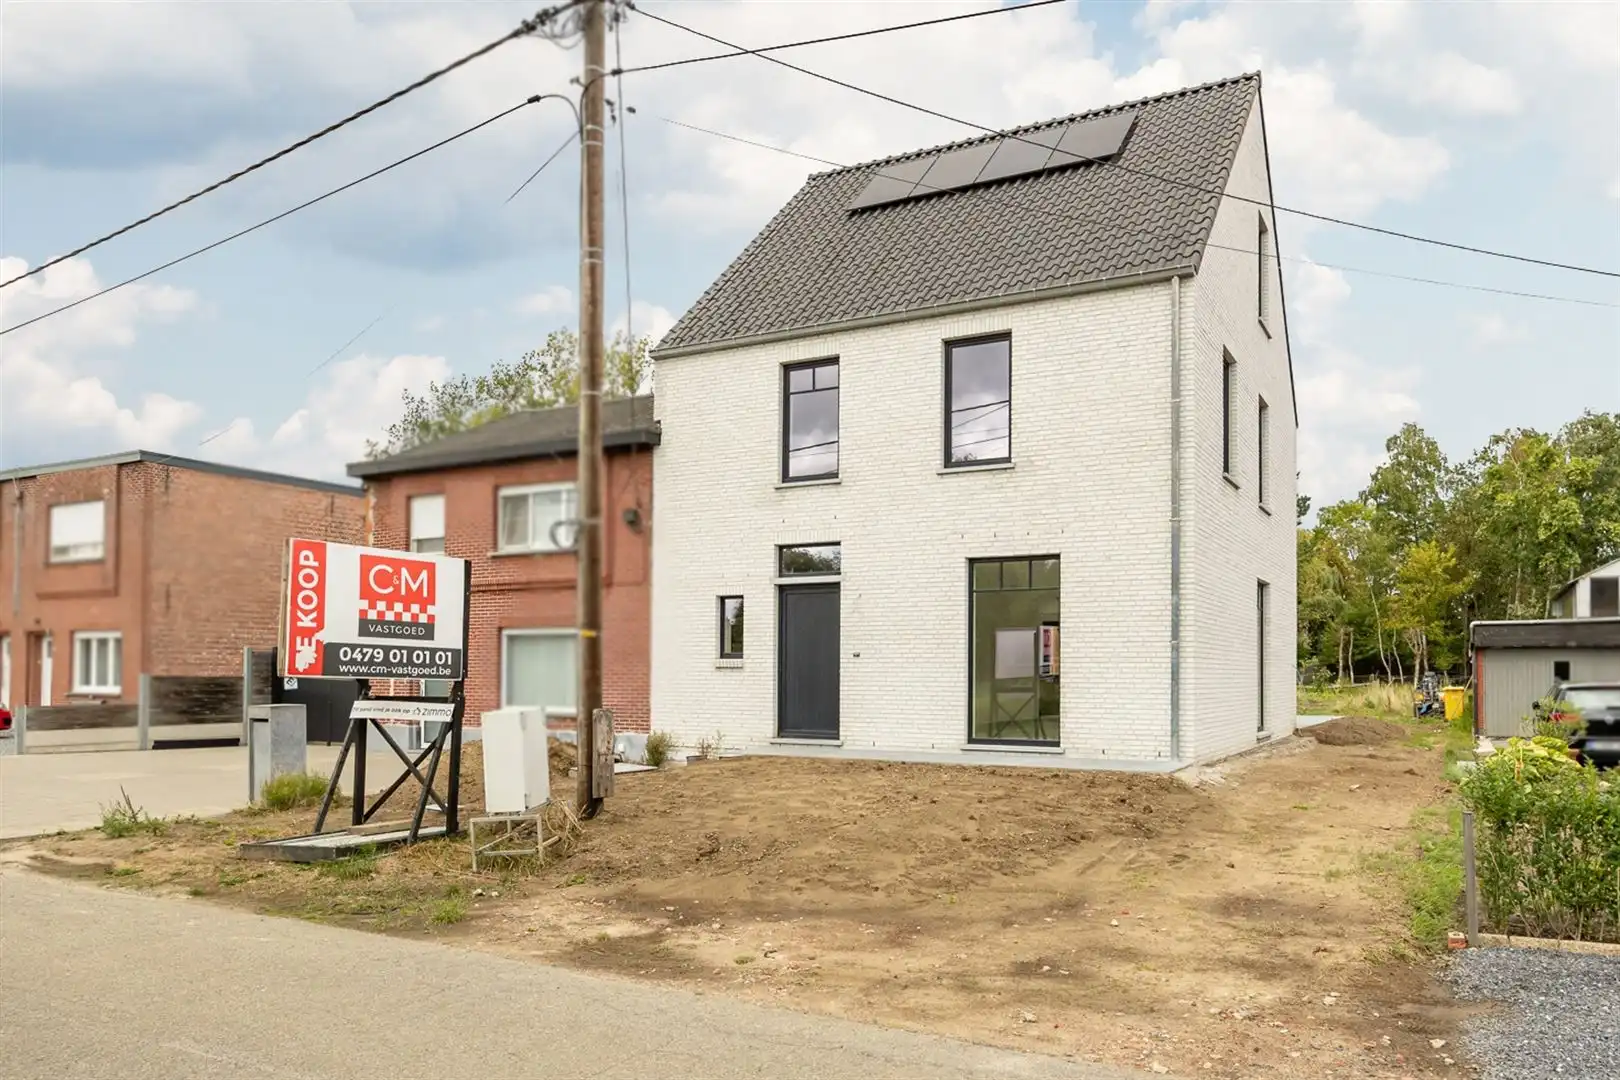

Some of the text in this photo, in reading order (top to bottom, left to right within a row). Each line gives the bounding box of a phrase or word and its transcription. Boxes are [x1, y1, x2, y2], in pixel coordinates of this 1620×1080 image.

[296, 549, 320, 627] KOOP
[368, 564, 428, 598] C&M
[368, 623, 426, 636] VASTGOED
[339, 646, 452, 665] 0479 01 01 01
[339, 664, 452, 677] www.cm-vastgoed.be
